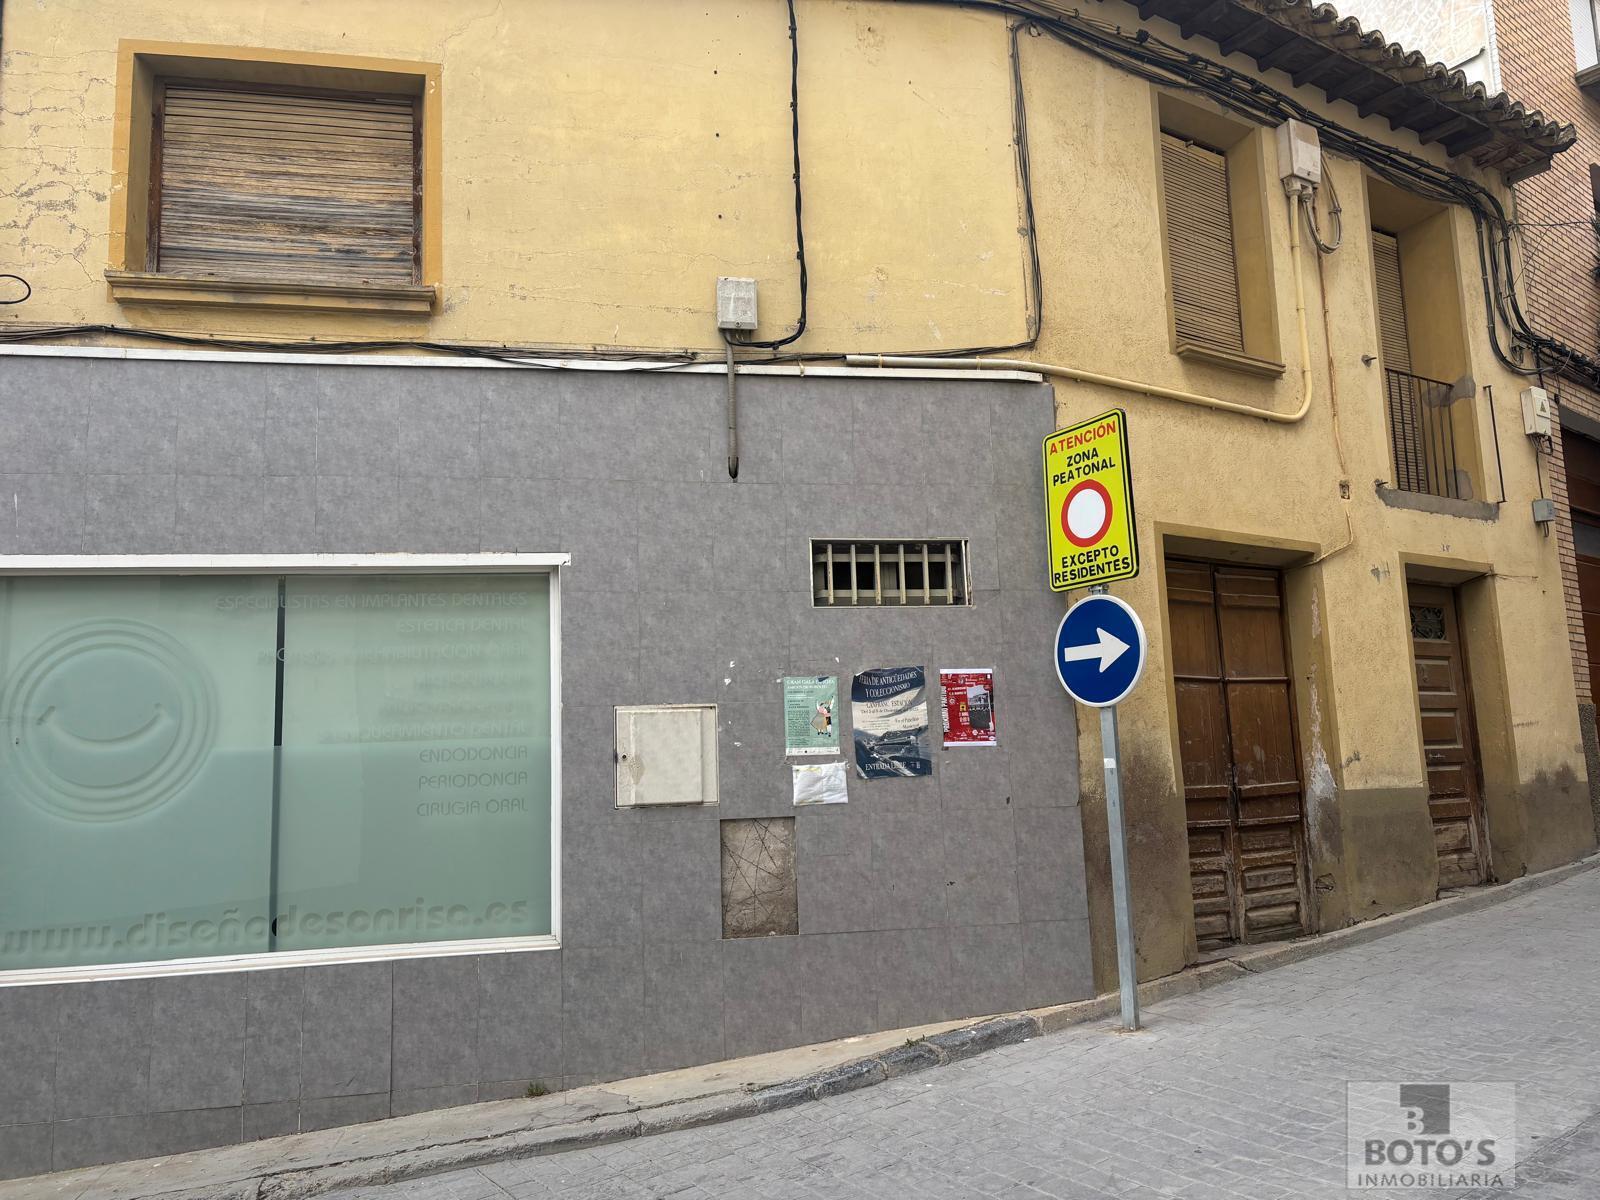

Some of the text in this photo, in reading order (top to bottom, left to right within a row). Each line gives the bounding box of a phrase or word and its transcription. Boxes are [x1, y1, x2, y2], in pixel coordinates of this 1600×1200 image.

[1050, 420, 1116, 455] ATENCIÓN
[1067, 447, 1099, 467] ZONA
[1053, 457, 1115, 486] PEATONAL
[1062, 545, 1119, 568] EXCEPTO
[1054, 557, 1130, 584] RESIDENTES
[334, 593, 355, 608] EN
[361, 592, 447, 608] IMPLANTES
[452, 591, 528, 607] DENTALES
[419, 745, 528, 763] ENDODONCIA
[418, 771, 528, 791] PERIODONCIA
[416, 798, 528, 816] CIRUGIA ORAL
